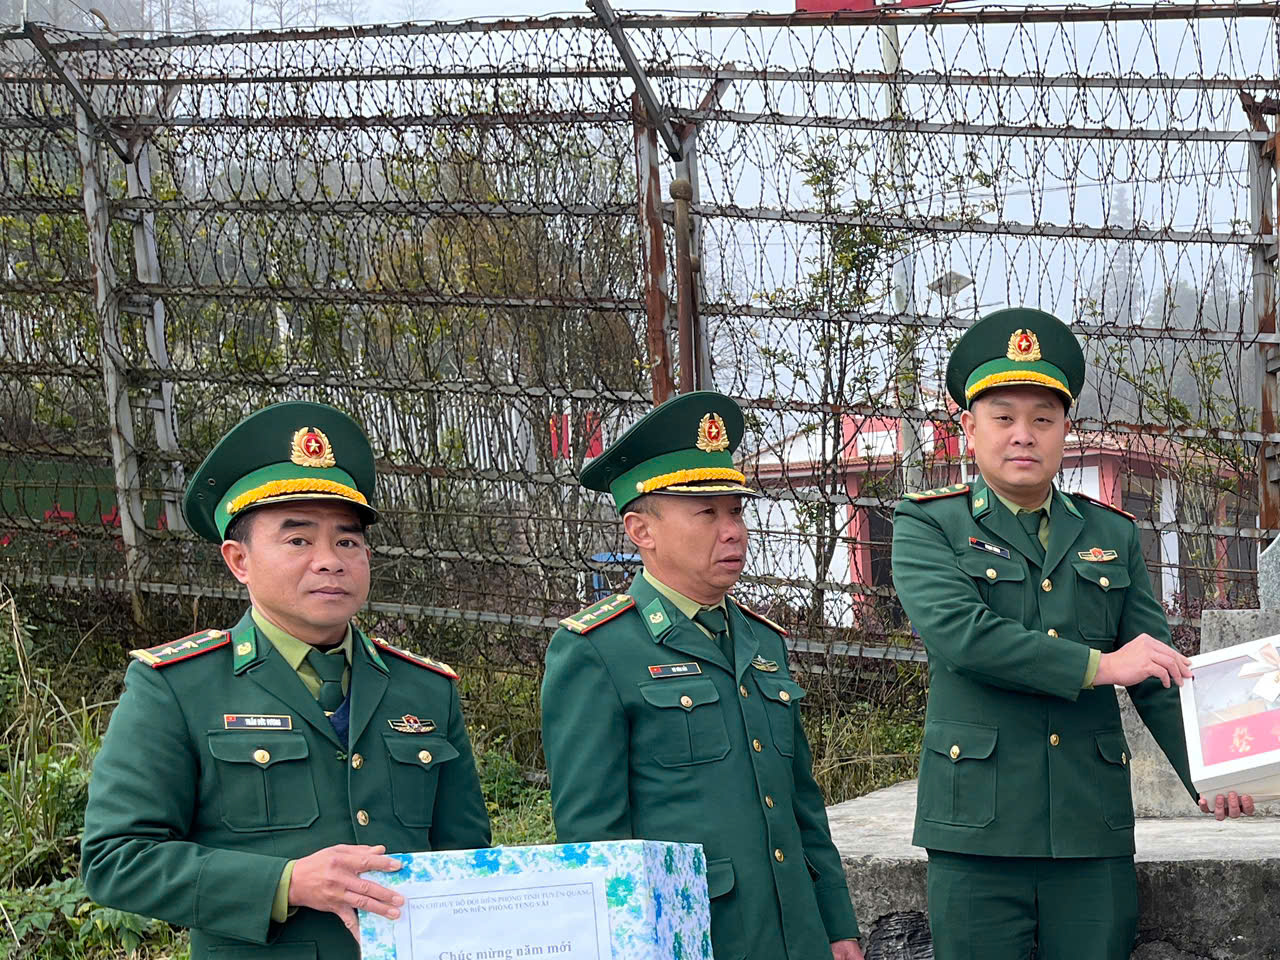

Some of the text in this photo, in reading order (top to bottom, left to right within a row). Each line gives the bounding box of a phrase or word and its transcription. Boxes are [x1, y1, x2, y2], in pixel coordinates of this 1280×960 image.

[475, 947, 512, 960] mừng
[515, 943, 544, 957] năm
[547, 940, 572, 954] mới
